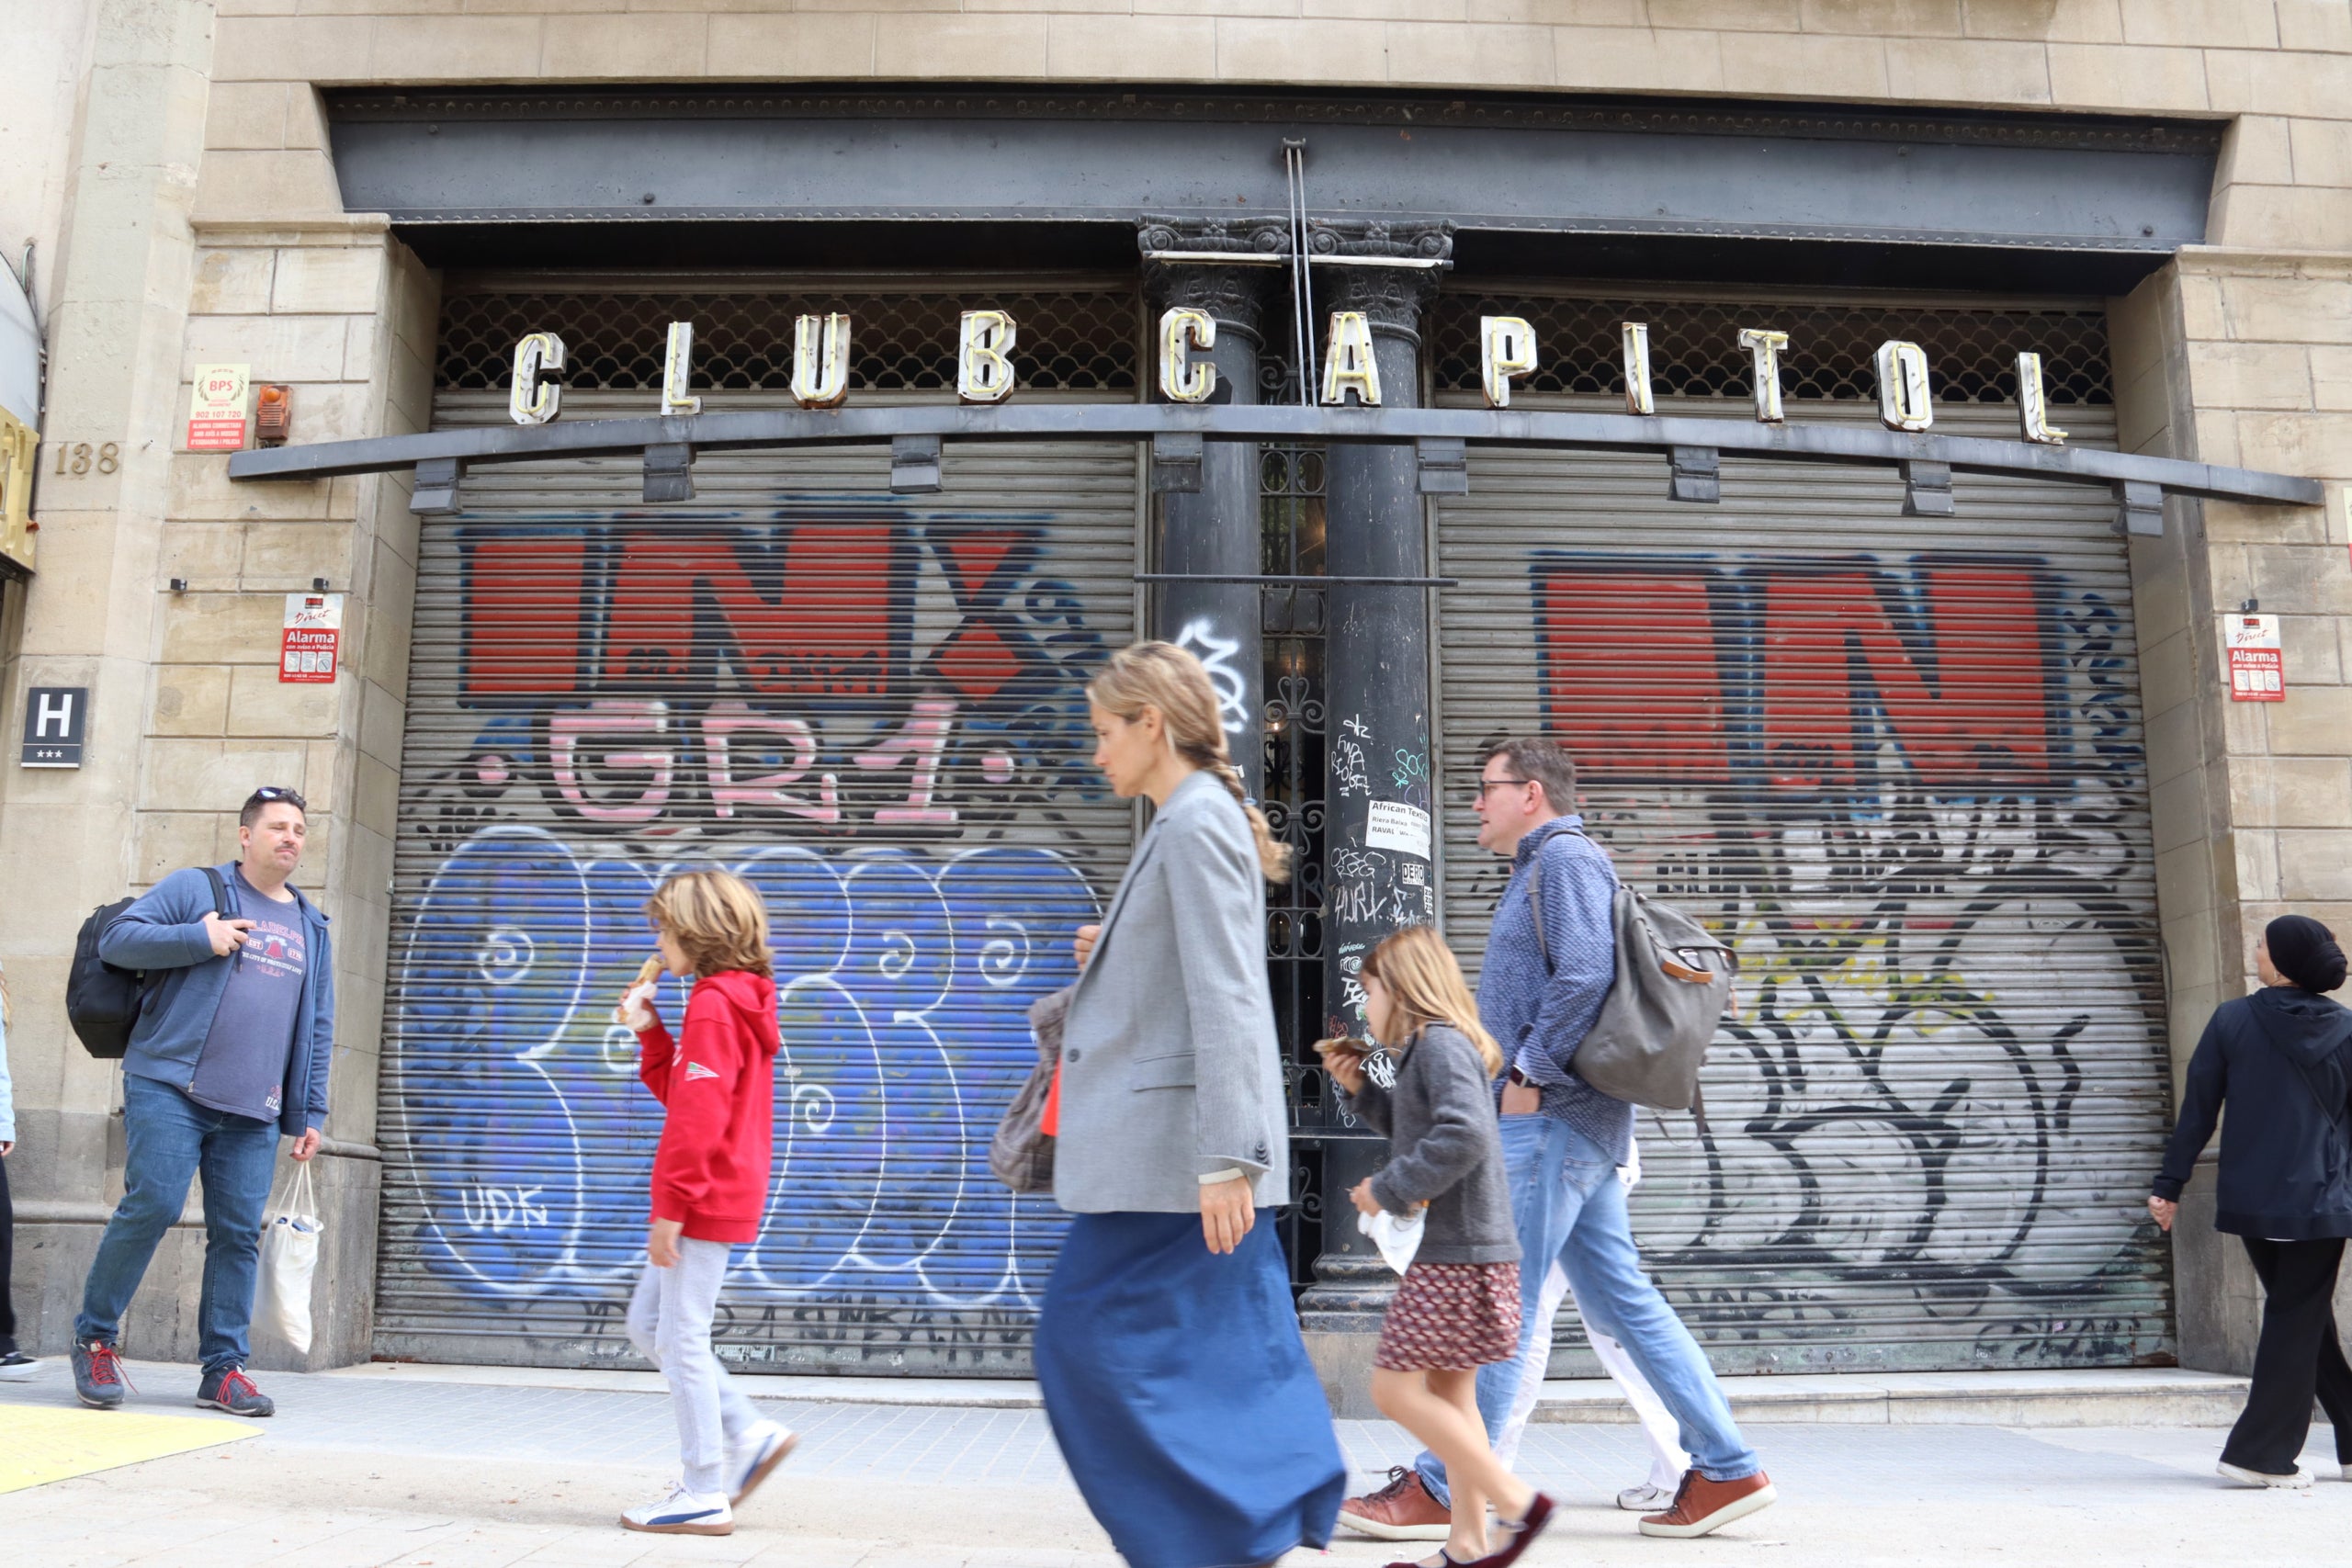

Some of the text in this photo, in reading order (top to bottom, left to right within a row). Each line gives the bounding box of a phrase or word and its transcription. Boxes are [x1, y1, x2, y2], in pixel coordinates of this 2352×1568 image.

[510, 306, 2069, 446] CLUB CAPITOL
[209, 379, 233, 391] BPS
[195, 411, 242, 419] 902 107 720
[55, 441, 119, 475] 138
[295, 609, 331, 625] Direct
[287, 630, 335, 644] Alarma
[2235, 628, 2268, 644] Direct
[2233, 649, 2278, 662] Alarma
[36, 694, 73, 738] H
[1373, 802, 1406, 814] African
[1373, 816, 1390, 824] Riera
[1391, 818, 1408, 827] Baixa
[1372, 826, 1395, 835] RAVAL
